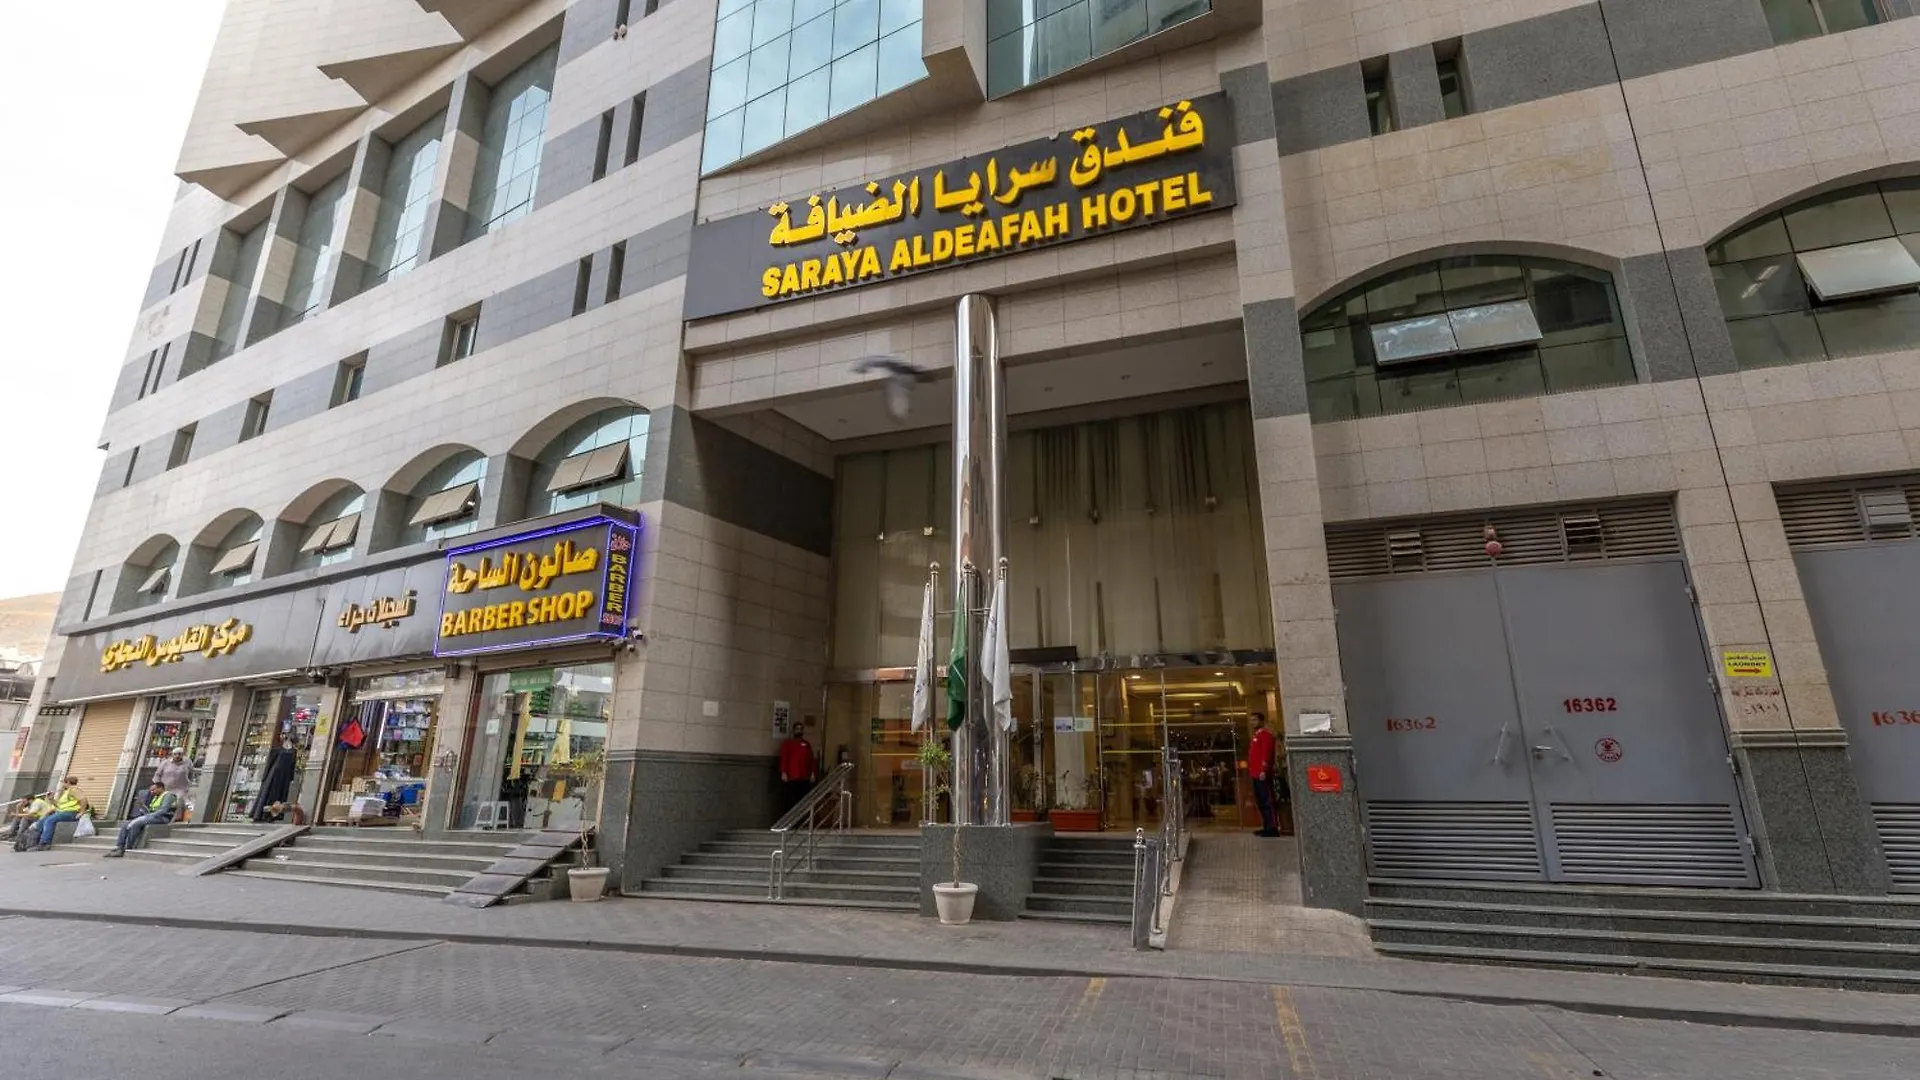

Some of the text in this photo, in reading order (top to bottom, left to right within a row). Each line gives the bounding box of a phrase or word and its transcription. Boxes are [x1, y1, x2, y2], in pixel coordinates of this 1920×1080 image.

[768, 100, 1204, 246] فندق سرايا الضيافة
[762, 171, 1213, 298] SARAYA ALDEAFAH HOTEL
[447, 539, 600, 594] صالون الساحة
[606, 553, 627, 614] BARBER
[202, 617, 251, 658] مركز
[440, 589, 595, 638] BARBER SHOP
[1387, 717, 1437, 732] 16362
[1563, 698, 1617, 714] 16362
